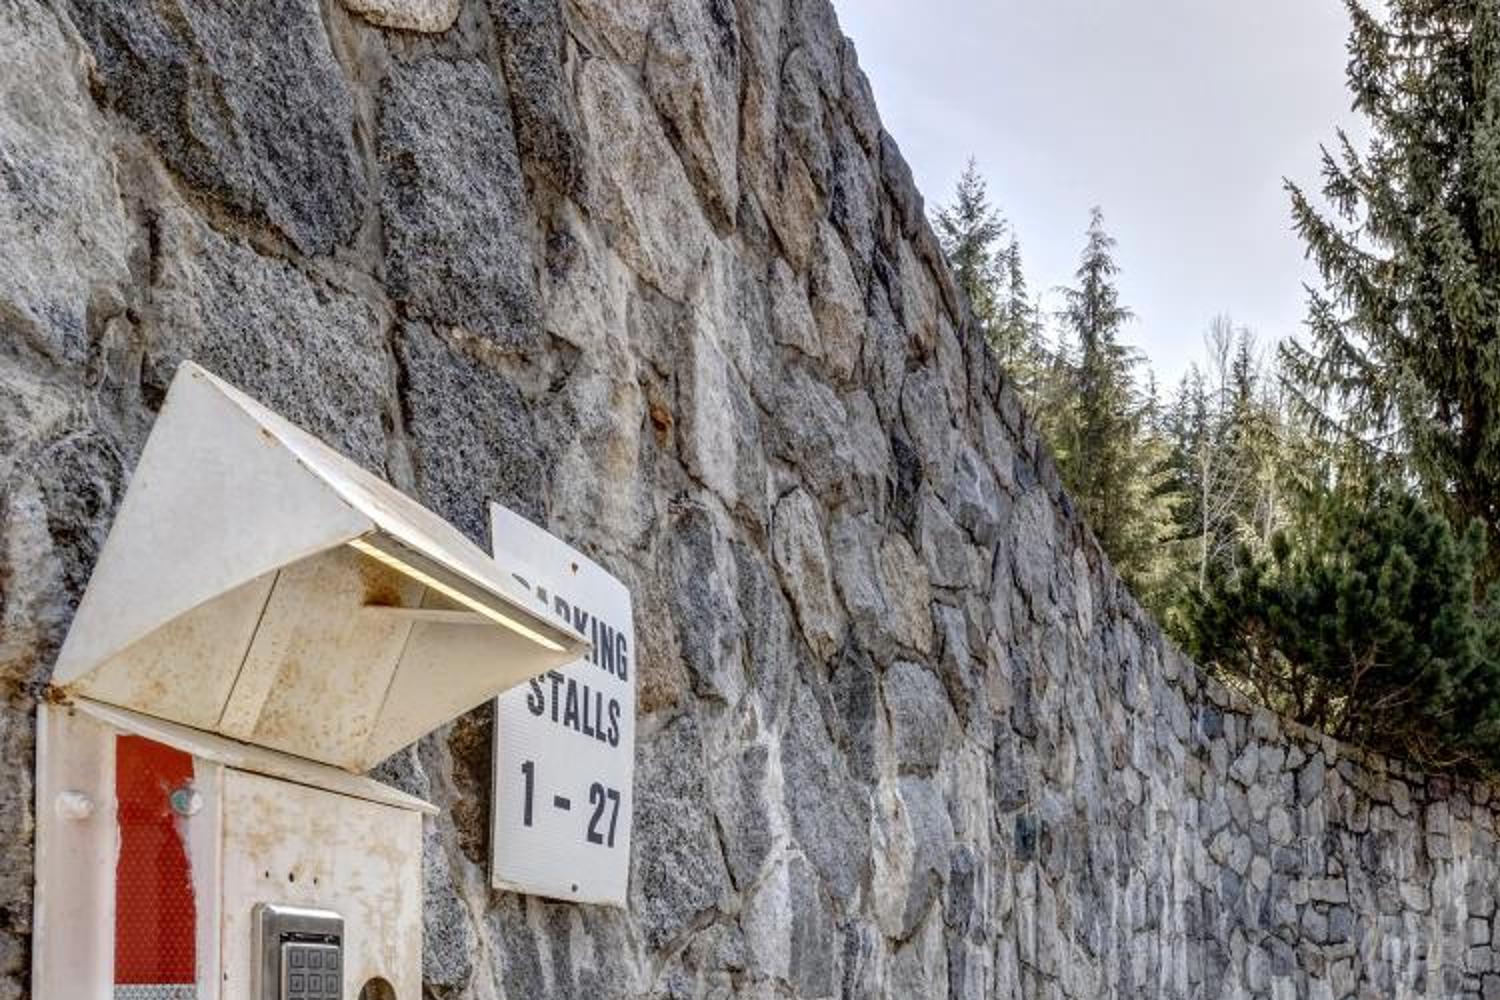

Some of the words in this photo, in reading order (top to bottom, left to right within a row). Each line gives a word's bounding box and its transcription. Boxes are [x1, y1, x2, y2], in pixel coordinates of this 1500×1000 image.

[511, 572, 628, 683] KING
[526, 669, 621, 748] STALLS
[521, 759, 535, 828] 1
[587, 781, 621, 849] 27
